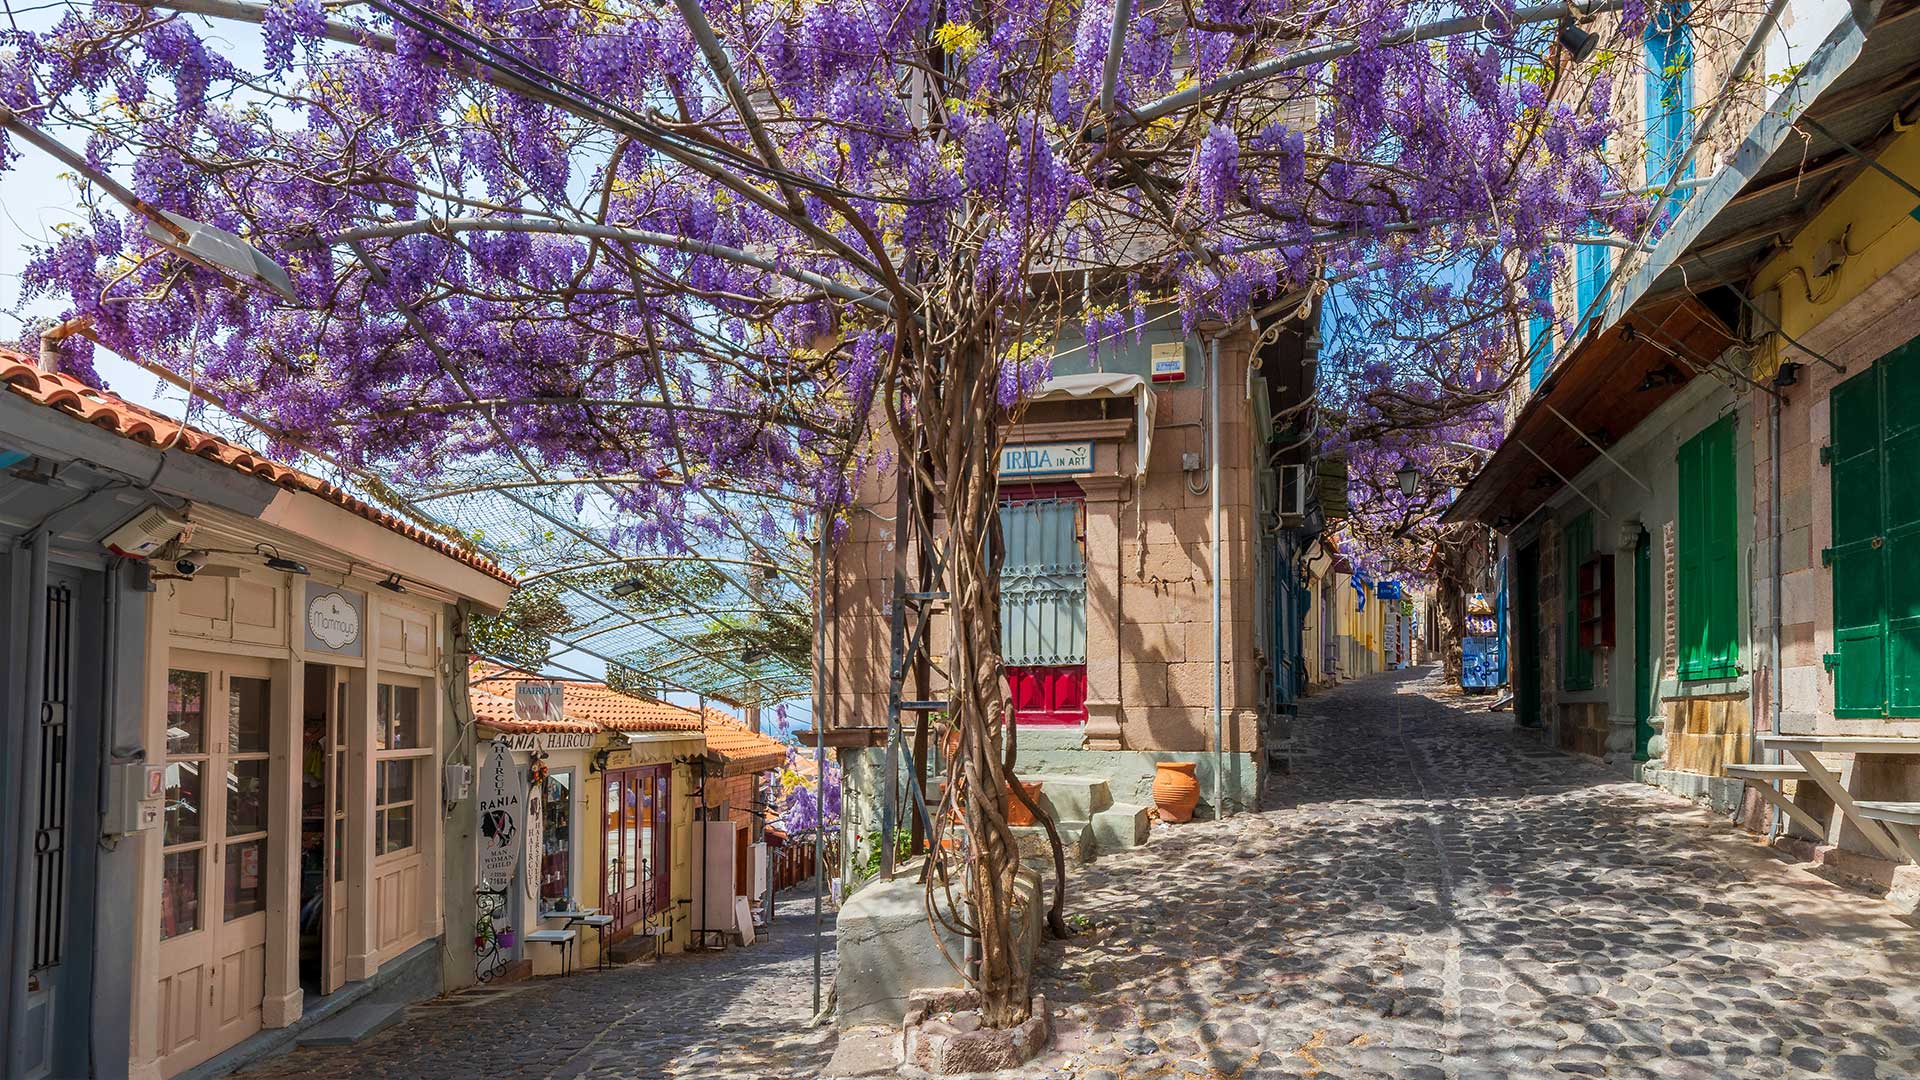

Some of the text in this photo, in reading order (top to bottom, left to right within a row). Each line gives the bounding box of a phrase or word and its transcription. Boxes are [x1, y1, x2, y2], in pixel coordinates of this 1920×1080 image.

[1005, 449, 1087, 470] IRIDA IN ART
[518, 686, 561, 695] HAIRCUT
[547, 734, 593, 748] HAIRCUT
[494, 746, 505, 796] HAIRCUT
[480, 795, 518, 811] RANIA
[484, 854, 514, 864] WOMAN
[491, 849, 508, 857] MAN
[487, 861, 512, 870] CHILD
